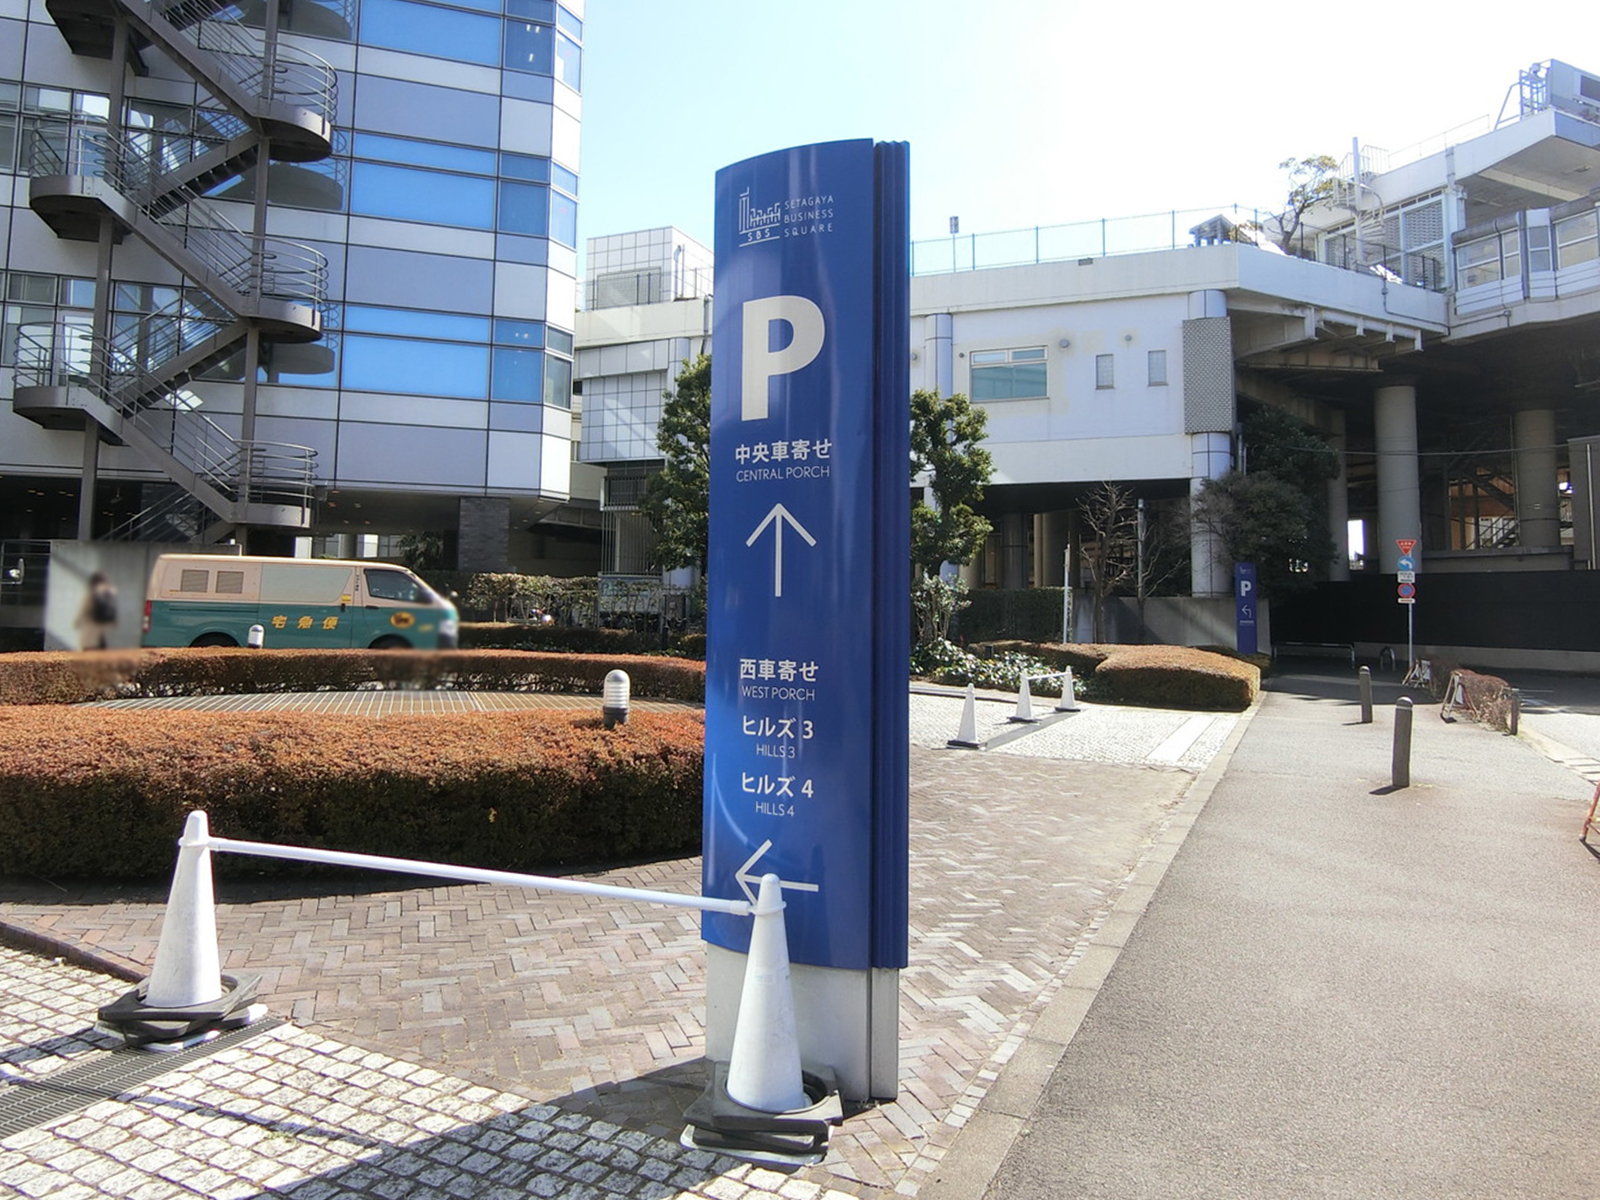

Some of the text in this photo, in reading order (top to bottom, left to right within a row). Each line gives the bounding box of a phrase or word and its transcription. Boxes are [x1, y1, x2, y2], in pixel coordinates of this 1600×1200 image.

[784, 195, 834, 210] SETAGAYA
[784, 208, 834, 224] BUSINESS
[747, 228, 771, 242] SBS
[784, 222, 833, 238] SQUARE
[741, 295, 826, 422] P
[735, 438, 833, 466] 中央車寄せ
[736, 465, 830, 483] CENTRAL PORCH
[1240, 580, 1252, 597] P
[739, 657, 820, 683] 西車寄せ
[741, 685, 816, 702] WEST PORCH
[742, 714, 815, 740] ヒルズ 3
[756, 743, 796, 759] HILLS 3
[741, 771, 814, 799] ヒルズ 4
[755, 800, 795, 818] HILLS 4
